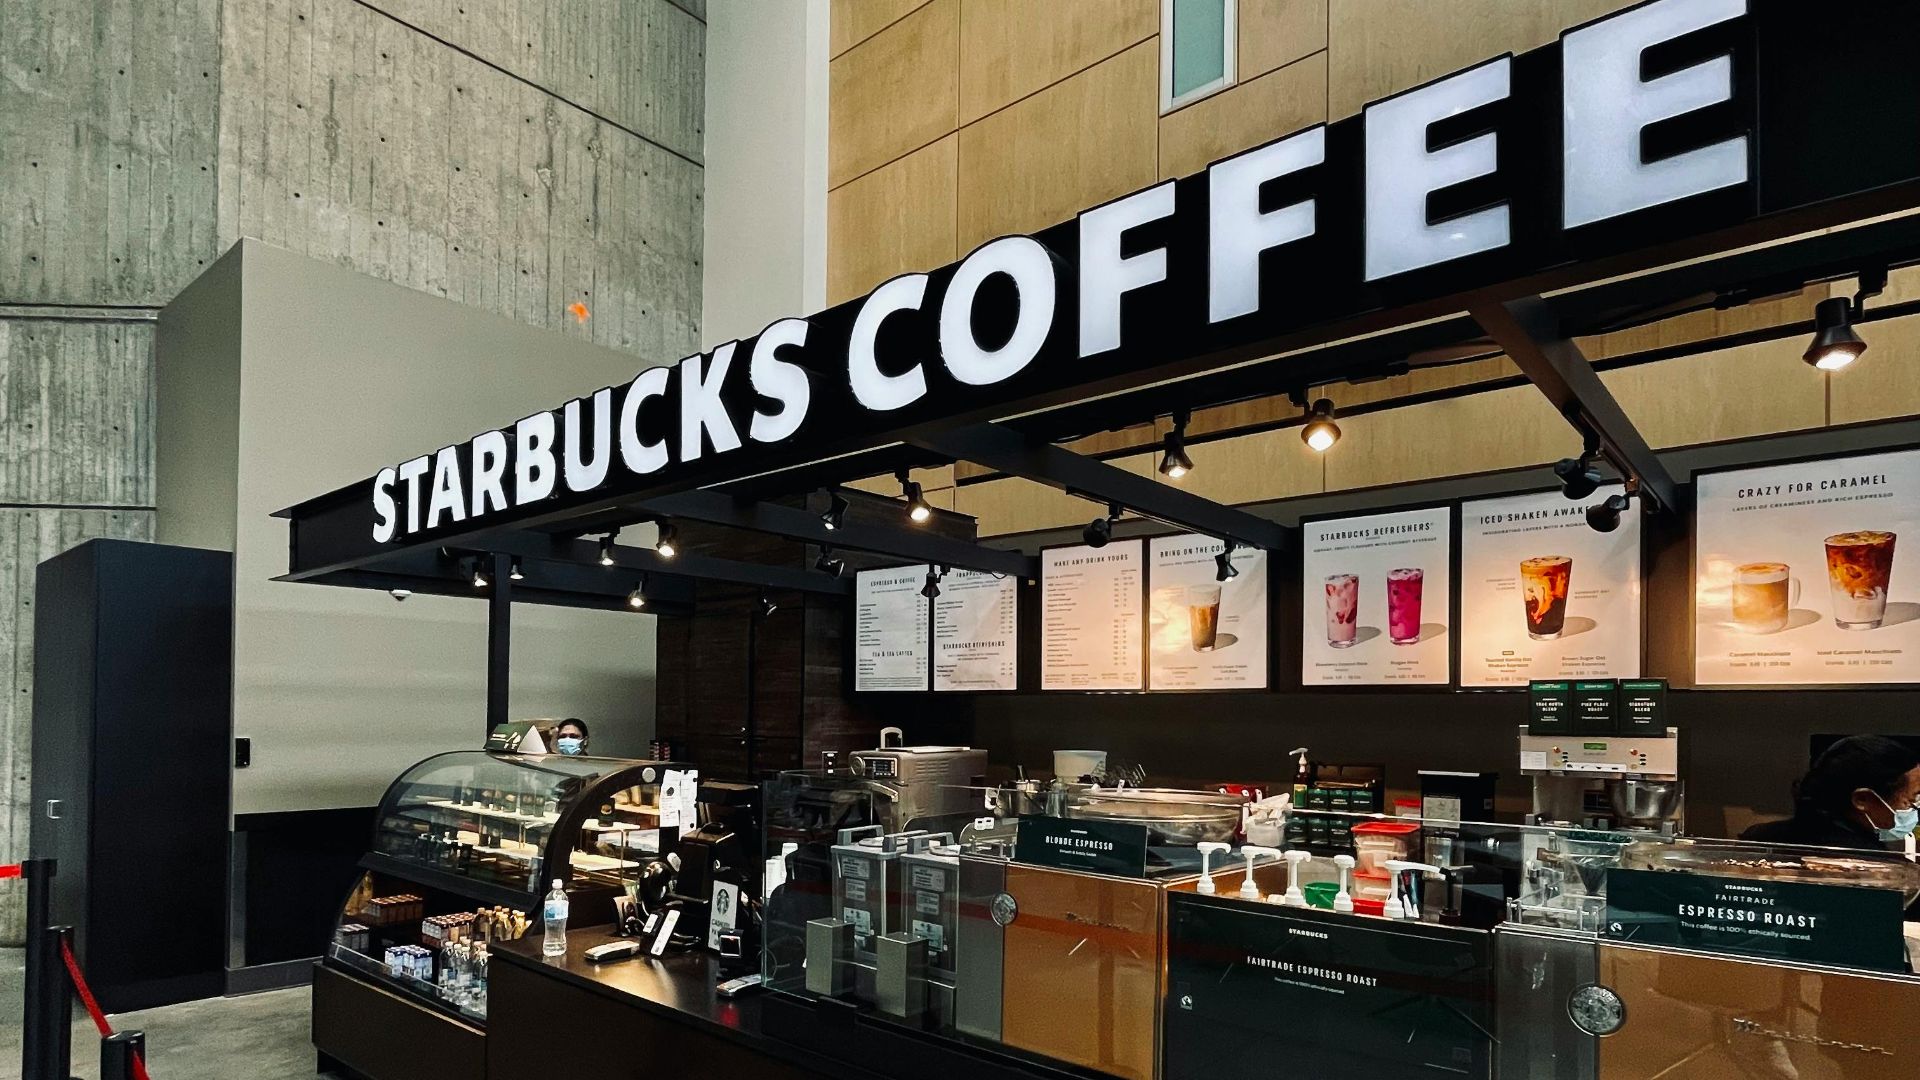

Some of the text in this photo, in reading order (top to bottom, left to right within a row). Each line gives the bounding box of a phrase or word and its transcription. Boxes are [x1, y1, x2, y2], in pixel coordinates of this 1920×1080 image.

[373, 0, 1749, 543] STARBUCKS COFFEE
[1738, 474, 1887, 499] CRAZY FOR CARAMEL
[1855, 492, 1894, 501] ESPRESSO
[1480, 515, 1503, 525] ICED
[1508, 509, 1548, 522] SHAKEN
[1320, 522, 1431, 542] STARBUCKS REFRESHERS
[1108, 554, 1128, 562] YOURS
[1160, 549, 1181, 558] BRING
[1196, 546, 1208, 554] THE
[943, 642, 971, 650] STARBUCKS
[1046, 836, 1113, 850] BLONDE ESPRESSO
[1725, 884, 1763, 892] STARBUCKS
[1715, 894, 1775, 906] FAIRTRADE
[1679, 904, 1816, 929] ESPRESSO ROAST
[1289, 928, 1328, 939] STARBUCKS
[1681, 921, 1695, 929] This
[1696, 923, 1718, 931] coffee
[1726, 926, 1747, 934] 100%
[1748, 929, 1778, 938] ethically
[1247, 956, 1293, 972] FAIRTRADE
[1297, 965, 1343, 981] ESPRESSO
[1346, 974, 1377, 987] ROAST
